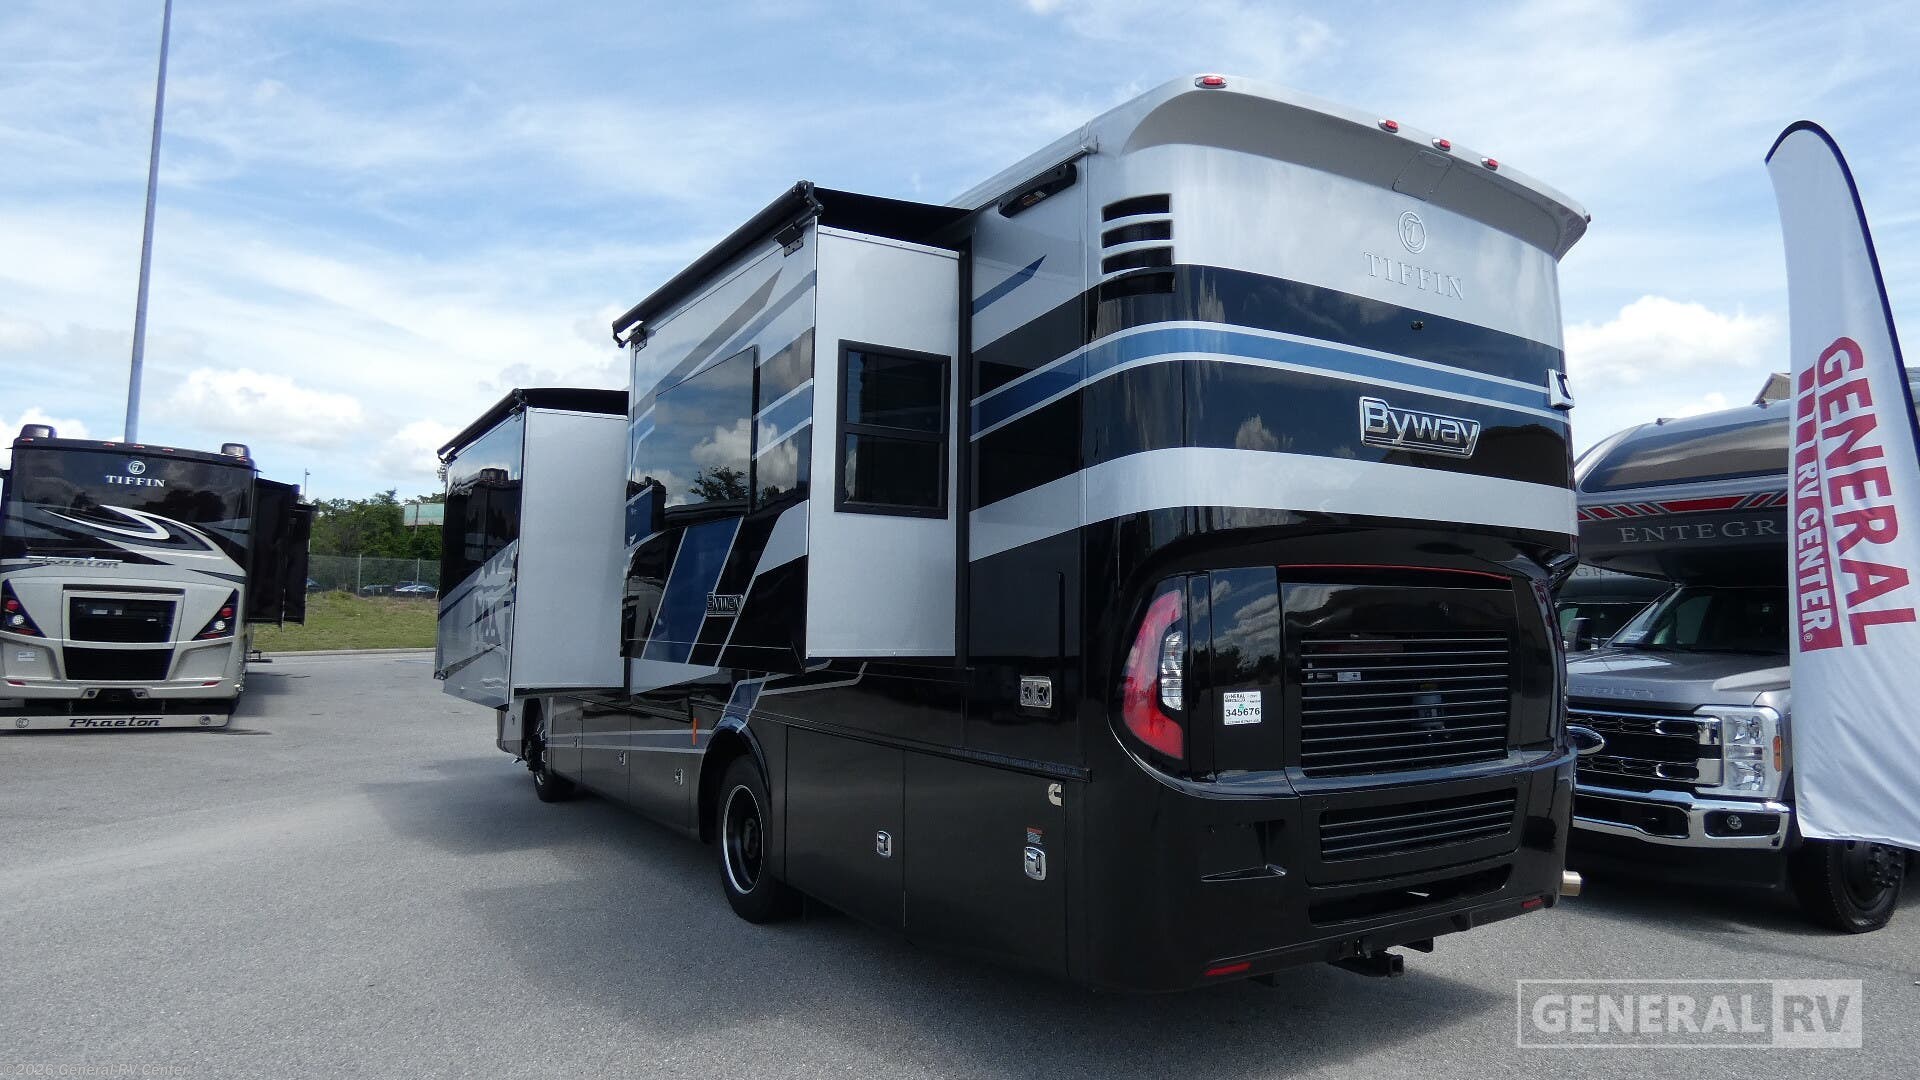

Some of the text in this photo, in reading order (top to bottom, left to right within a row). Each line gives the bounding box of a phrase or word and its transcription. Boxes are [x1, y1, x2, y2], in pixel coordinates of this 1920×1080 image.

[1363, 251, 1463, 300] TIFFIN
[1363, 400, 1478, 454] Byway
[105, 474, 166, 488] TIFFIN
[1795, 461, 1818, 499] RV
[1816, 336, 1917, 646] GENERAL
[1618, 519, 1780, 543] ENTEGR
[69, 717, 163, 728] Phaeton
[1225, 707, 1260, 717] 345676
